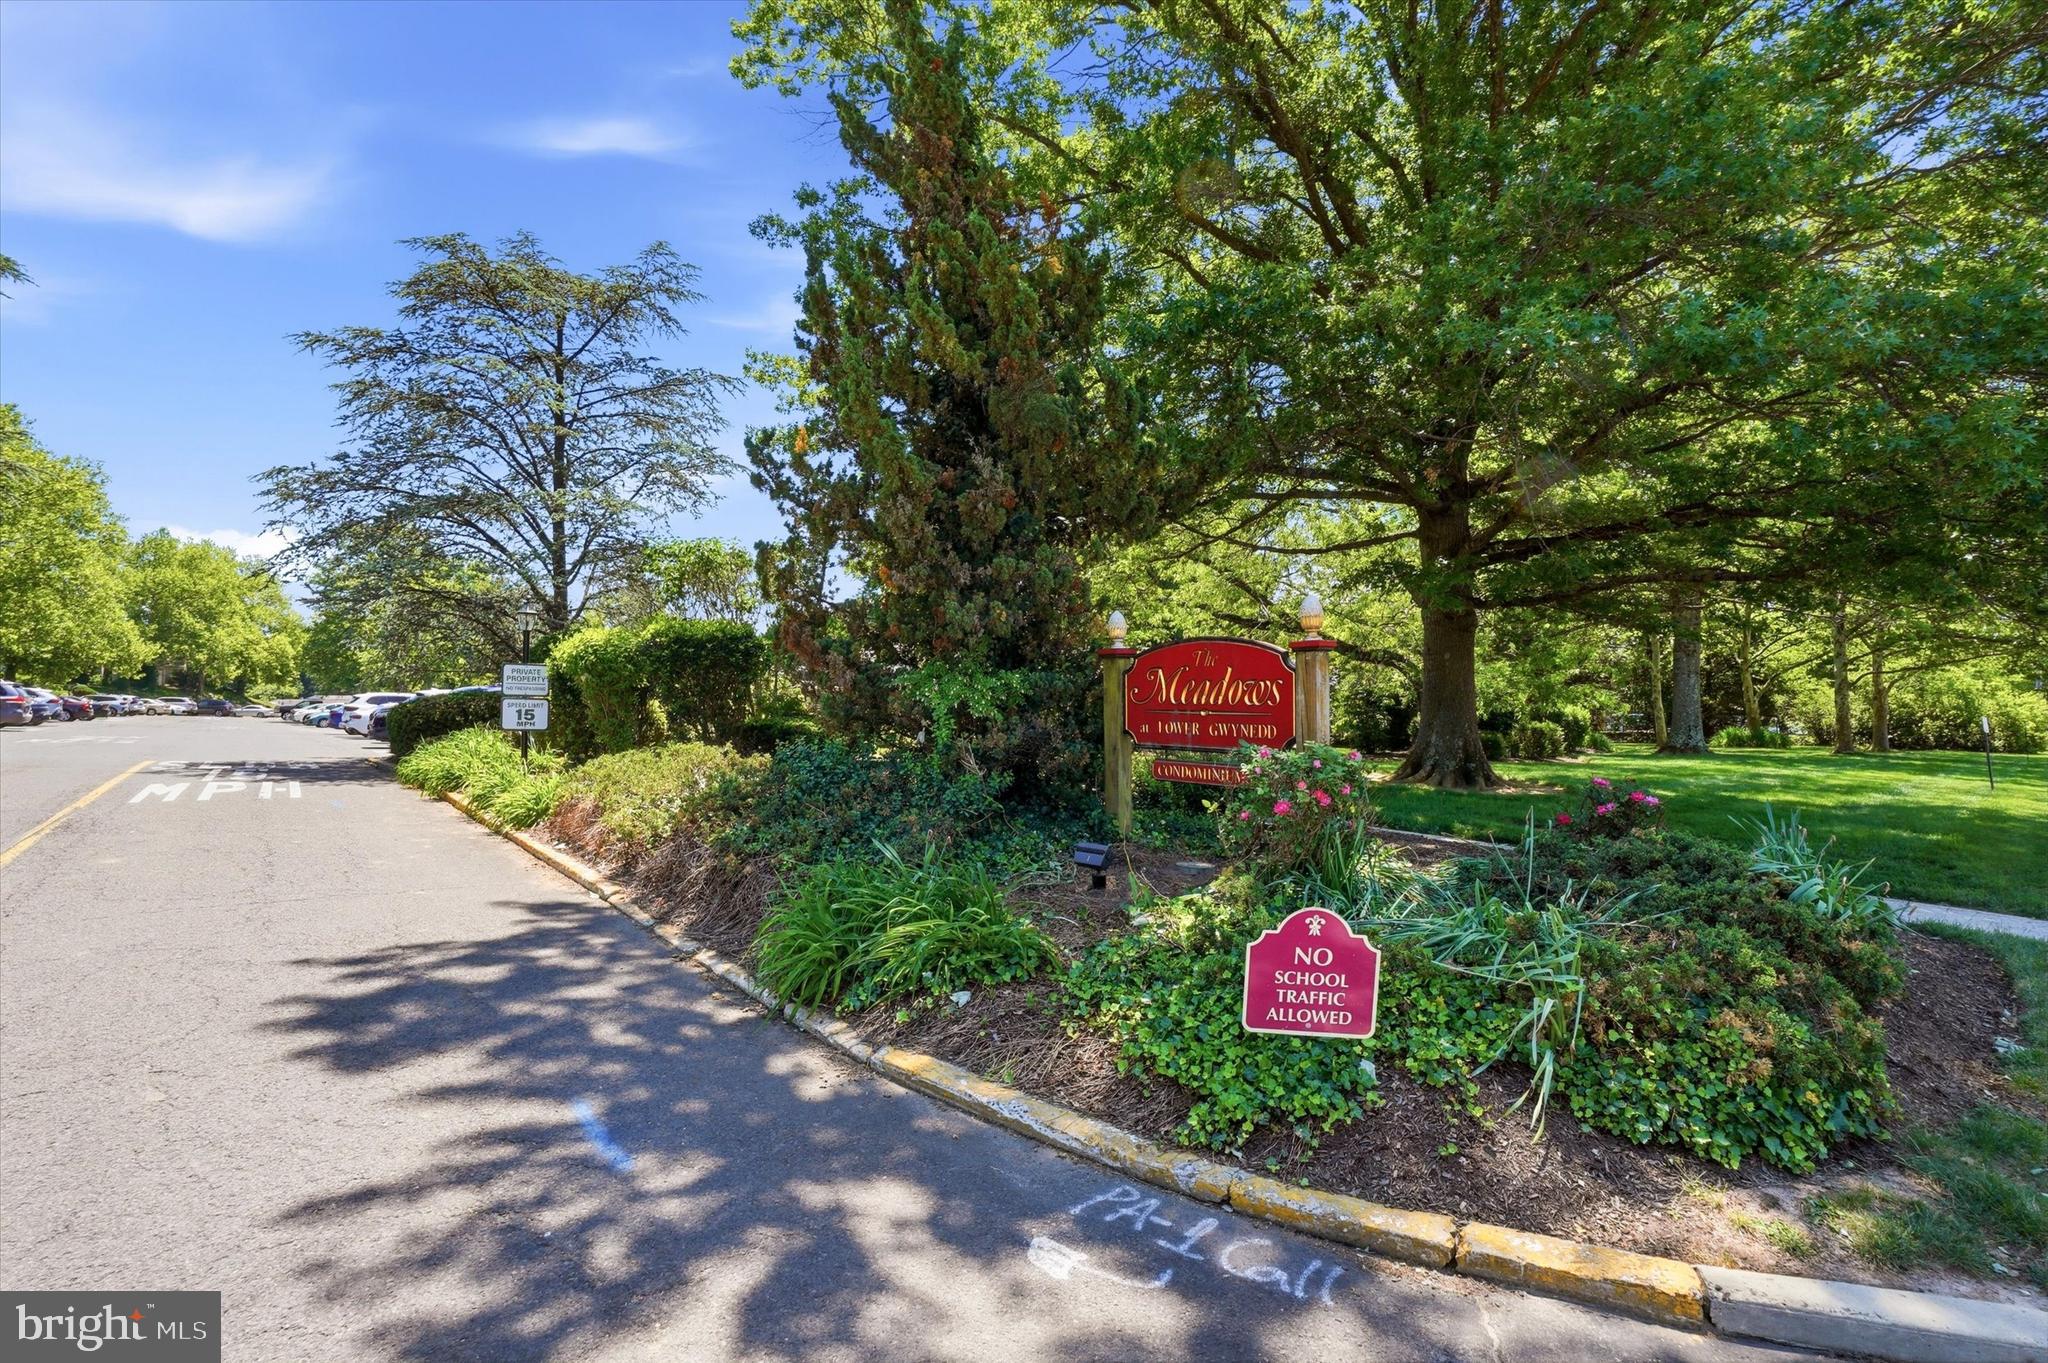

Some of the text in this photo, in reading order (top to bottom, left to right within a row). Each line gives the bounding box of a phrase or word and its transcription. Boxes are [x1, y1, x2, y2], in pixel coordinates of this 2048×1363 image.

[1192, 648, 1219, 667] The
[511, 668, 541, 676] PRIVATE
[1130, 666, 1284, 707] Meadows
[516, 709, 536, 721] 15
[1140, 720, 1277, 739] at LOWER GWYNEDD
[128, 781, 302, 803] MPH
[1294, 946, 1334, 967] NO
[1274, 970, 1349, 988] SCHOOL
[1276, 989, 1346, 1006] TRAFFIC
[1266, 1007, 1352, 1025] ALLOWED
